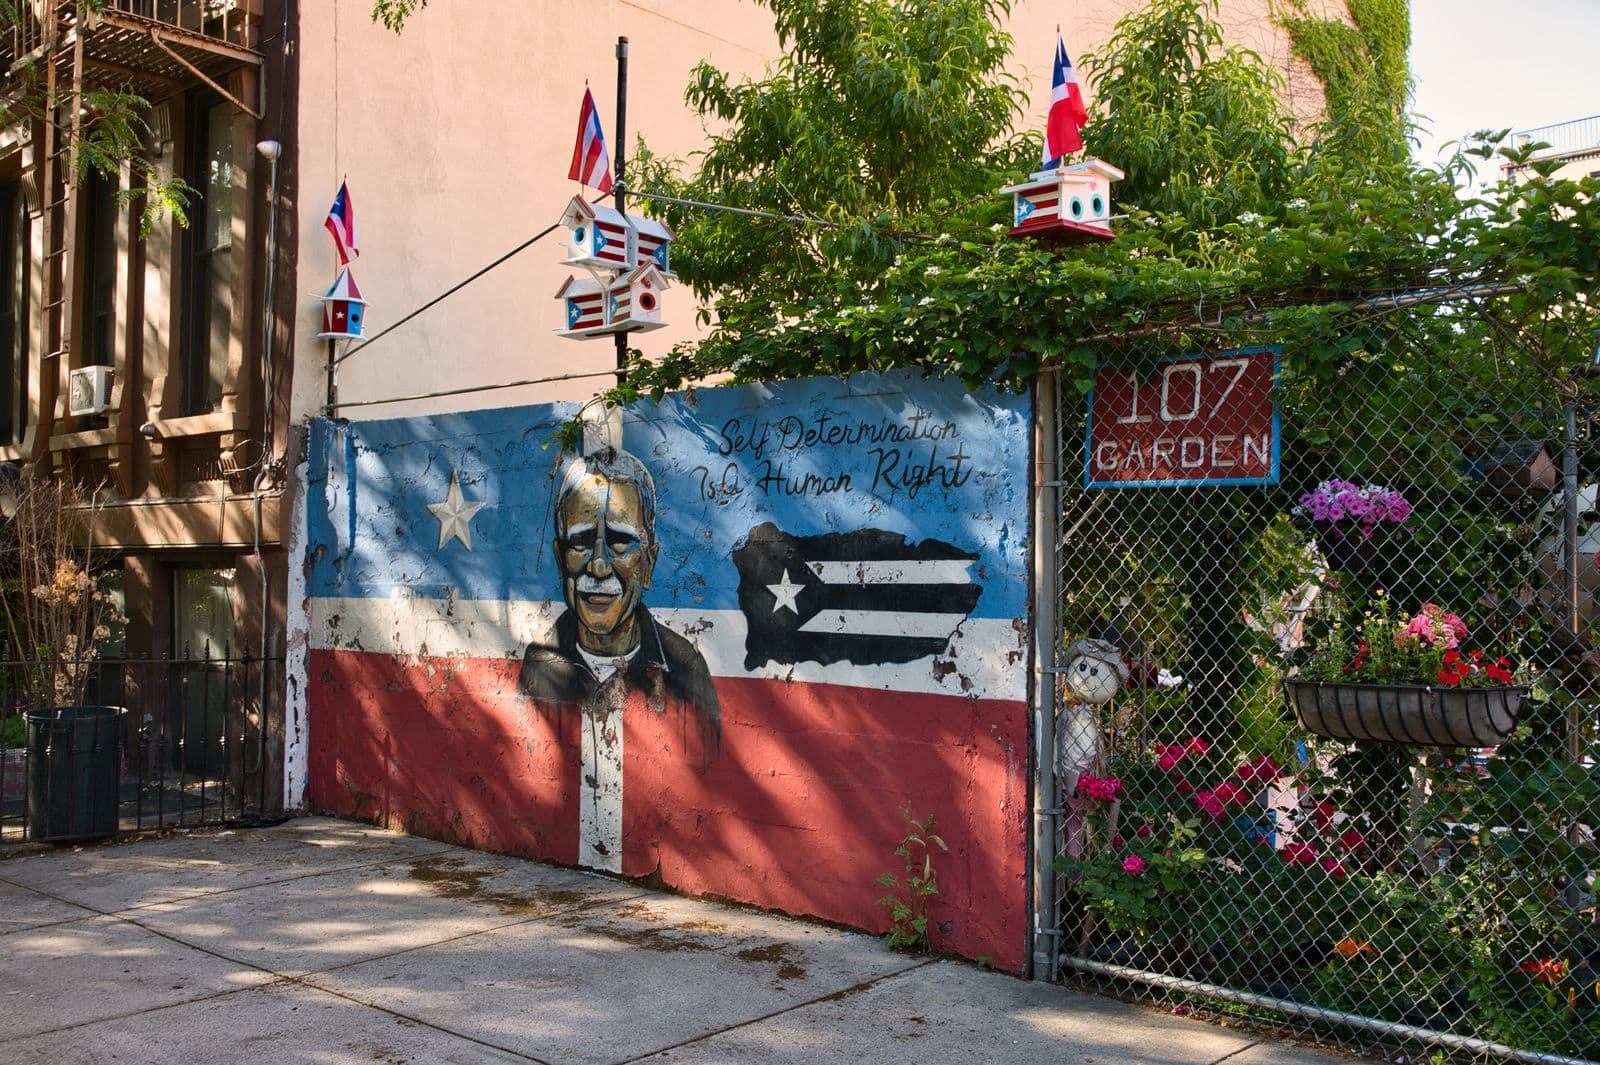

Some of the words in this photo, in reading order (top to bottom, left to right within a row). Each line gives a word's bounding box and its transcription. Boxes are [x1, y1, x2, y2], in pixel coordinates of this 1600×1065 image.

[1116, 358, 1250, 424] 107
[718, 415, 770, 460] Self
[775, 407, 960, 451] Determination
[1096, 433, 1269, 471] GARDEN
[755, 459, 853, 497] Human
[867, 441, 973, 500] Right
